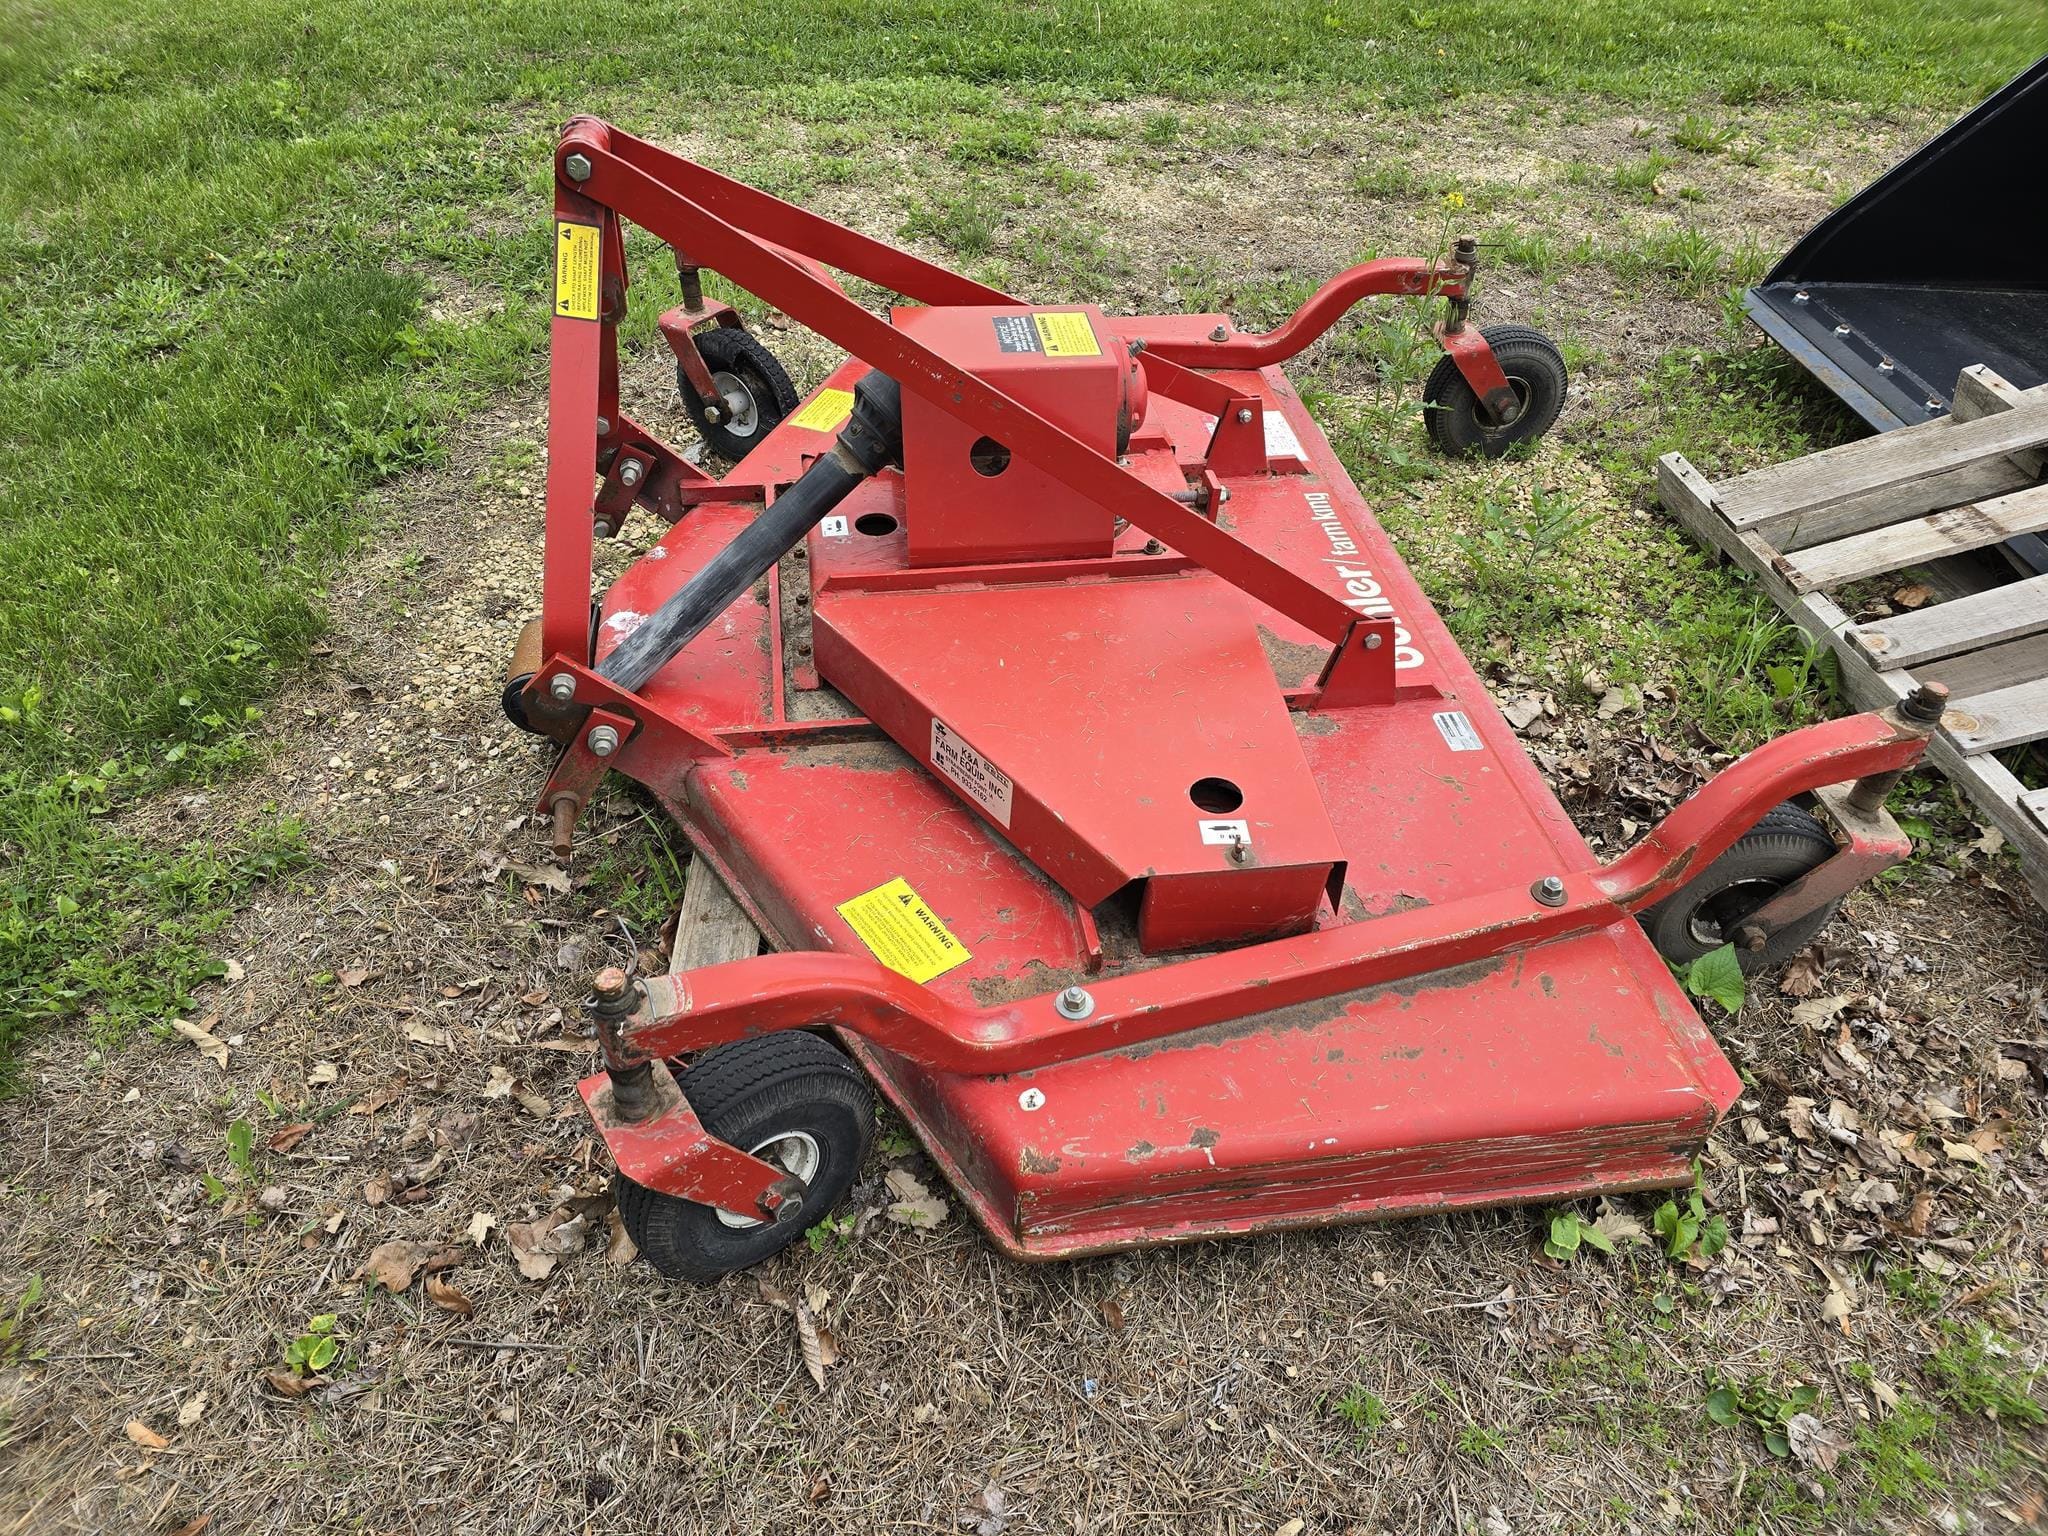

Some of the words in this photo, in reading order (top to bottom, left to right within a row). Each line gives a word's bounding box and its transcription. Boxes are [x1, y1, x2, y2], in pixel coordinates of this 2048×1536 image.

[1038, 316, 1053, 341] WARNING
[1303, 492, 1338, 521] king
[1321, 521, 1360, 556] farm
[935, 735, 958, 761] FARM
[988, 780, 1006, 802] INC.
[945, 755, 974, 782] STRAWBERRY
[961, 747, 979, 768] K&A
[950, 766, 961, 780] PH.
[915, 908, 954, 950] WARNING
